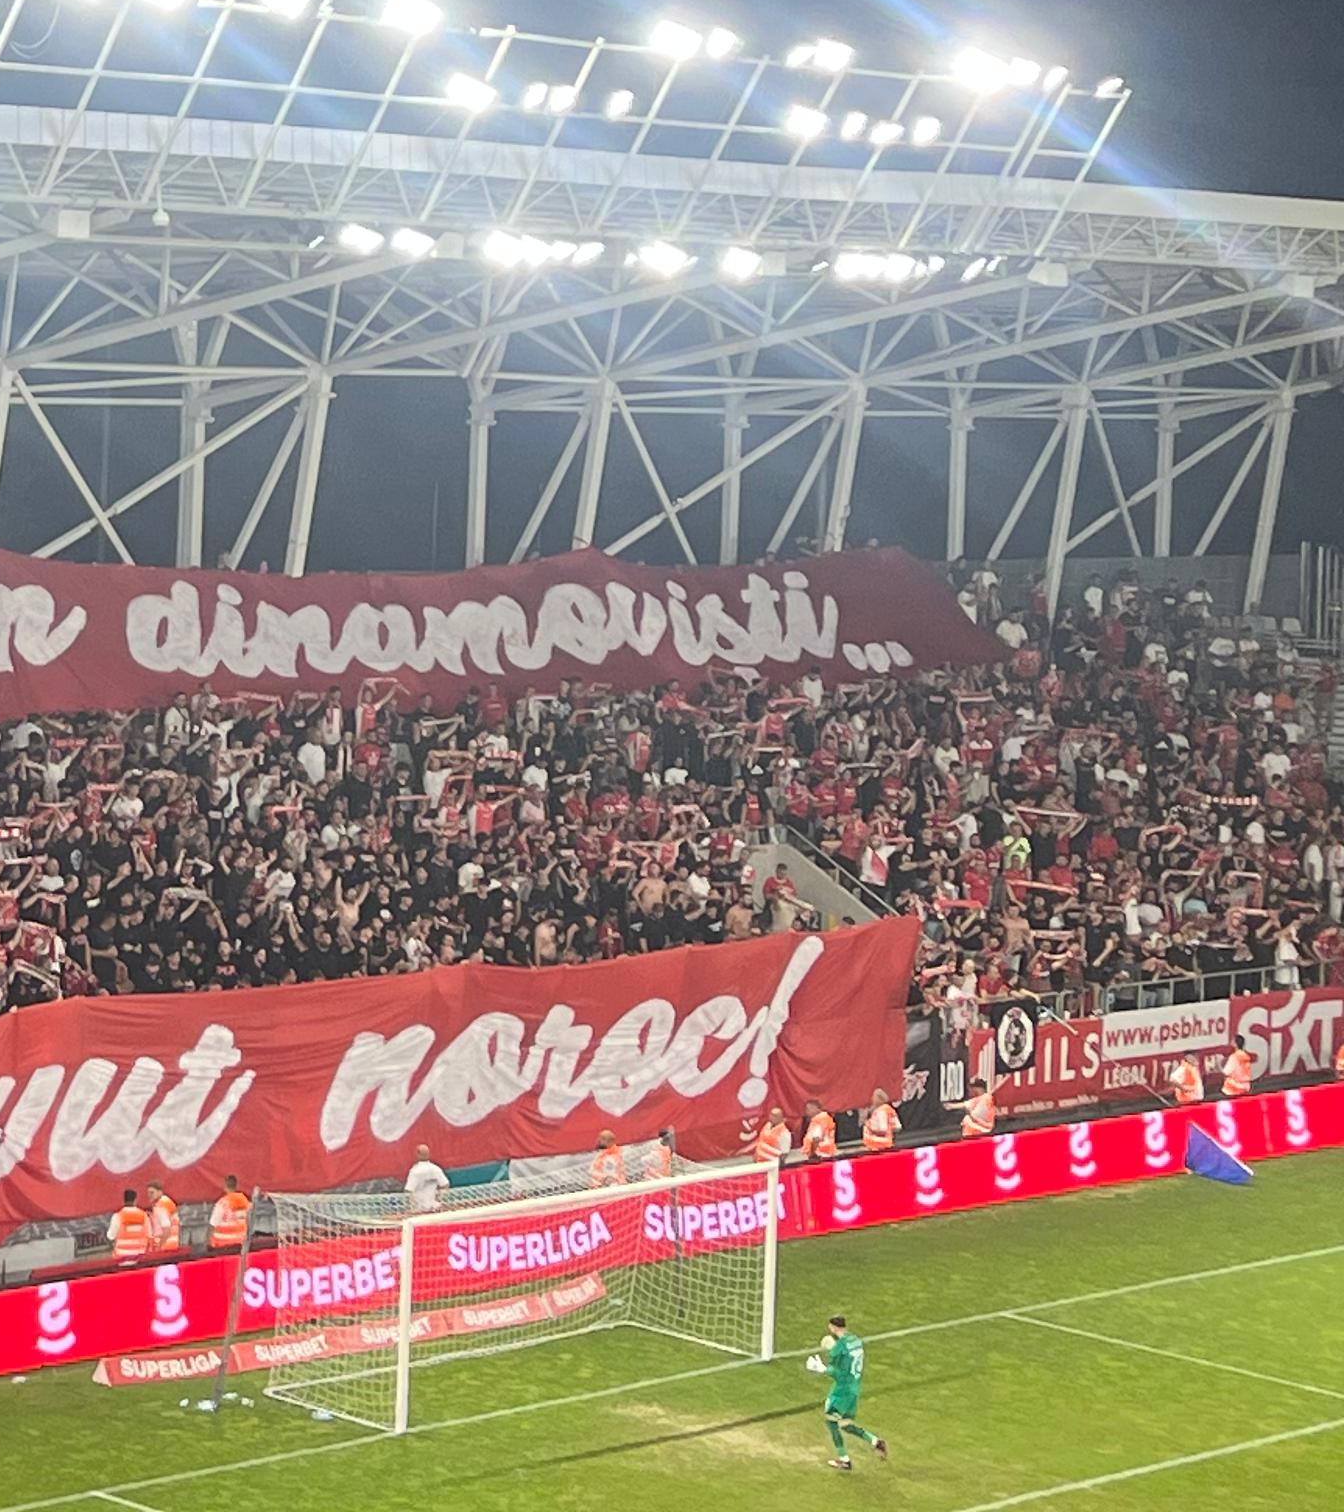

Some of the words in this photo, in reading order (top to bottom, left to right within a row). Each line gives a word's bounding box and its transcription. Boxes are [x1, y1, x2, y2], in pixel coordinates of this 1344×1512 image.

[319, 937, 823, 1152] noroc!
[1105, 1015, 1226, 1048] www.psbh.ro
[243, 1249, 404, 1309] SUPERBET
[447, 1212, 613, 1273] SUPERLIGA
[360, 1317, 432, 1347] SUPEBET
[120, 1351, 222, 1379] SUPERLIGA
[254, 1335, 329, 1364] SUPERBET
